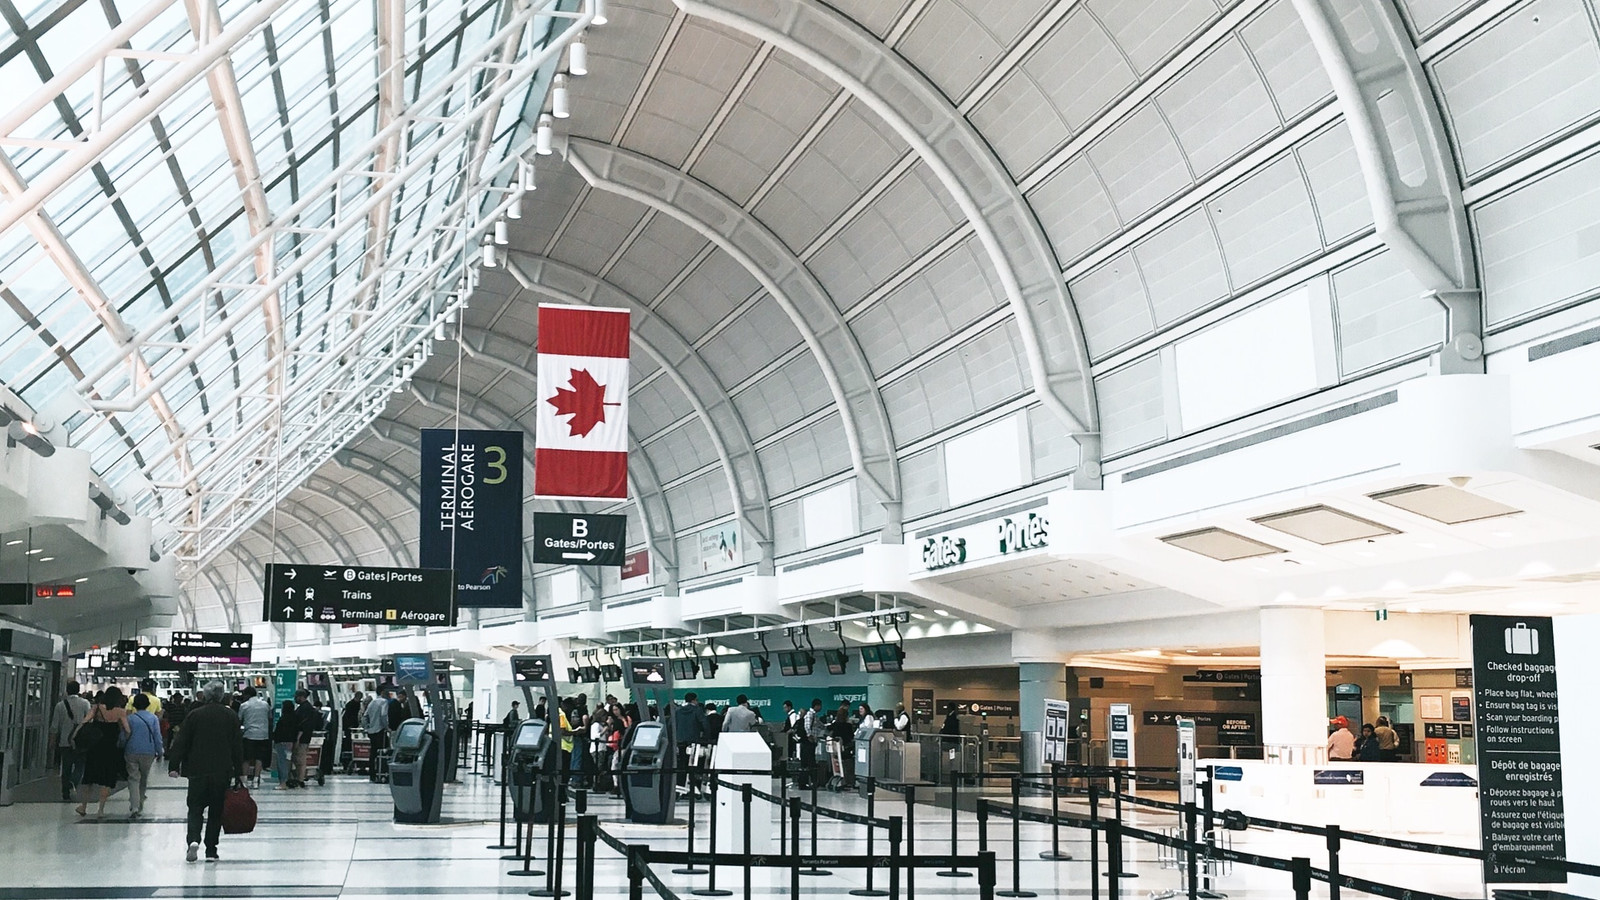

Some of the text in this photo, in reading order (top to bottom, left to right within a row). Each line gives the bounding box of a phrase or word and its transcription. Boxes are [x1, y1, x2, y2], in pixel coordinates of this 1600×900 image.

[483, 446, 508, 484] 3
[441, 444, 456, 530] TERMINAL
[458, 444, 475, 531] AÉROGARE
[572, 518, 588, 538] B
[544, 538, 614, 550] Gates/Portes
[922, 513, 1049, 571] Gates Portes
[342, 590, 372, 600] Trains
[341, 609, 383, 619] Terminal
[401, 612, 445, 622] Aérogare
[1487, 662, 1556, 673] Checked baggag
[1507, 673, 1540, 683] drop-off
[1485, 689, 1504, 697] Place
[1506, 690, 1518, 698] bag
[1511, 702, 1524, 710] bag
[1526, 702, 1538, 711] tag
[1522, 715, 1552, 724] boarding
[1510, 726, 1554, 734] instructions
[1492, 760, 1560, 771] Dépôt de bagage
[1505, 772, 1553, 782] enregistrés
[1490, 788, 1520, 797] Déposez
[1522, 789, 1548, 798] bagage
[1538, 811, 1564, 820] l'étique
[1503, 821, 1529, 830] bagage
[1492, 833, 1520, 842] Balayez
[1492, 844, 1554, 852] d'embarquement
[1494, 865, 1525, 873] à l'écran
